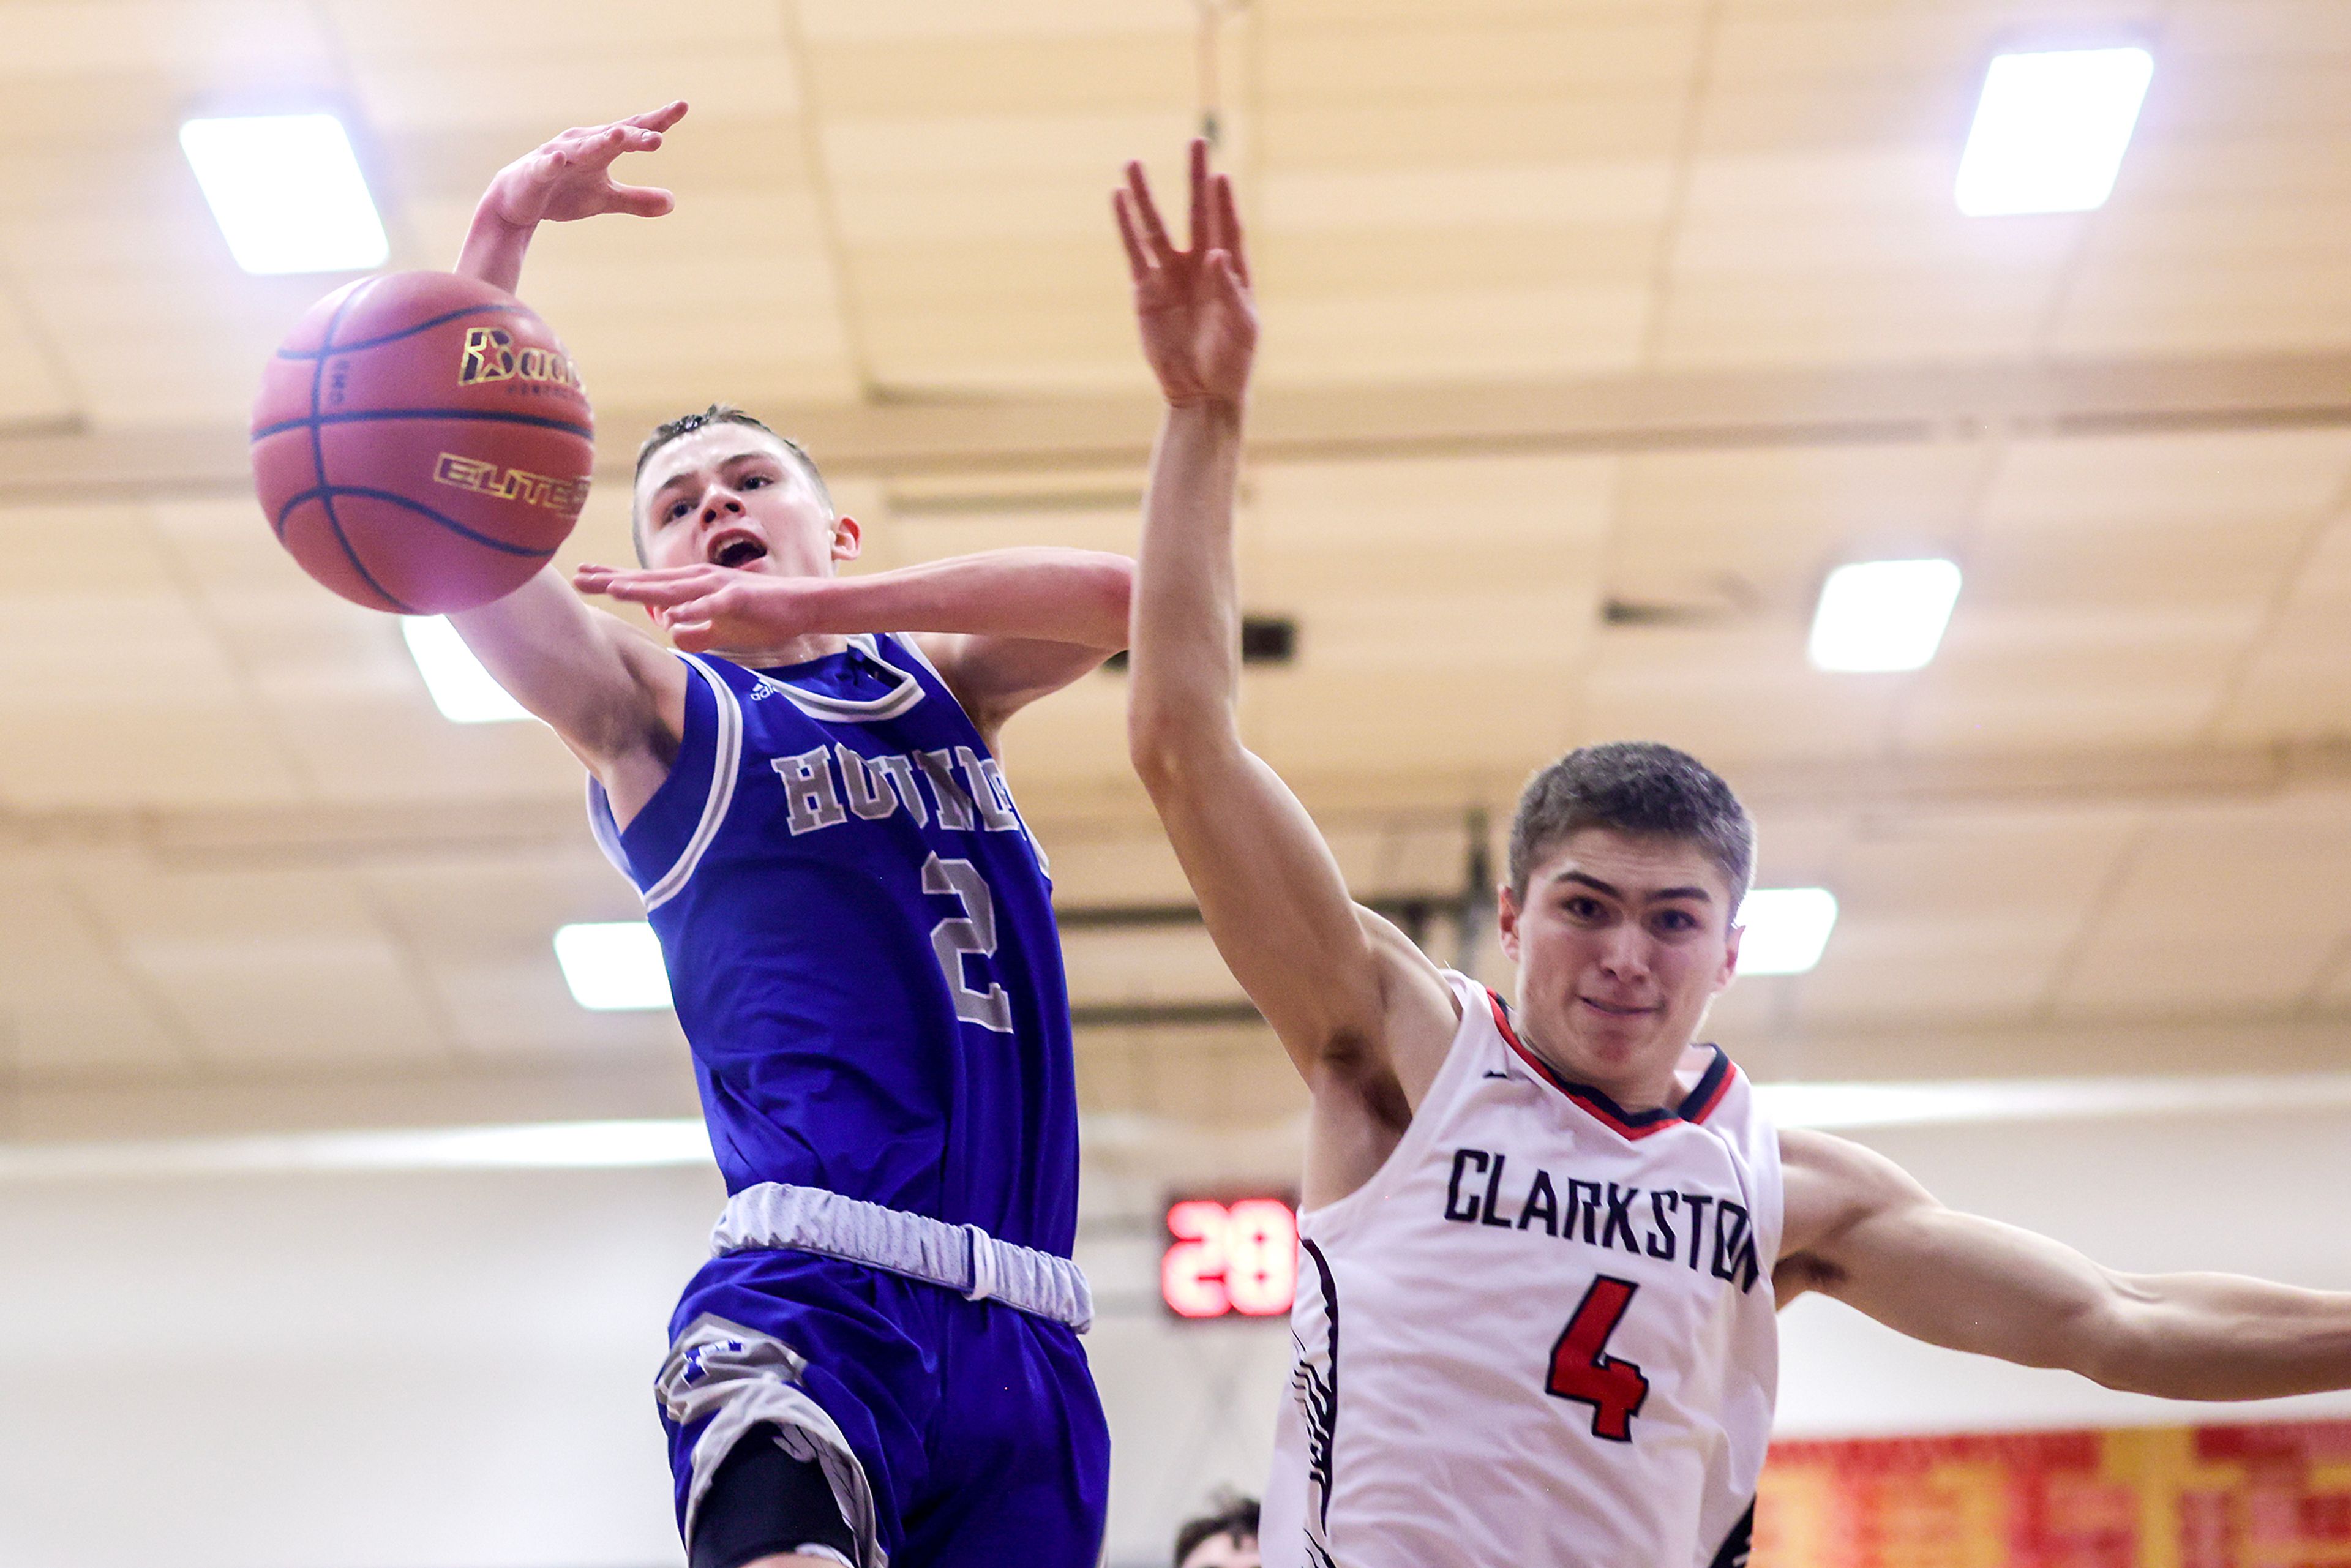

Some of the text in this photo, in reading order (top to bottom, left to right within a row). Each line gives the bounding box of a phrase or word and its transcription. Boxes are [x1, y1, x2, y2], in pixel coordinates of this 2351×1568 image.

[920, 850, 1014, 1034] 2
[1161, 1198, 1299, 1318] 28
[1545, 1273, 1649, 1443] 4
